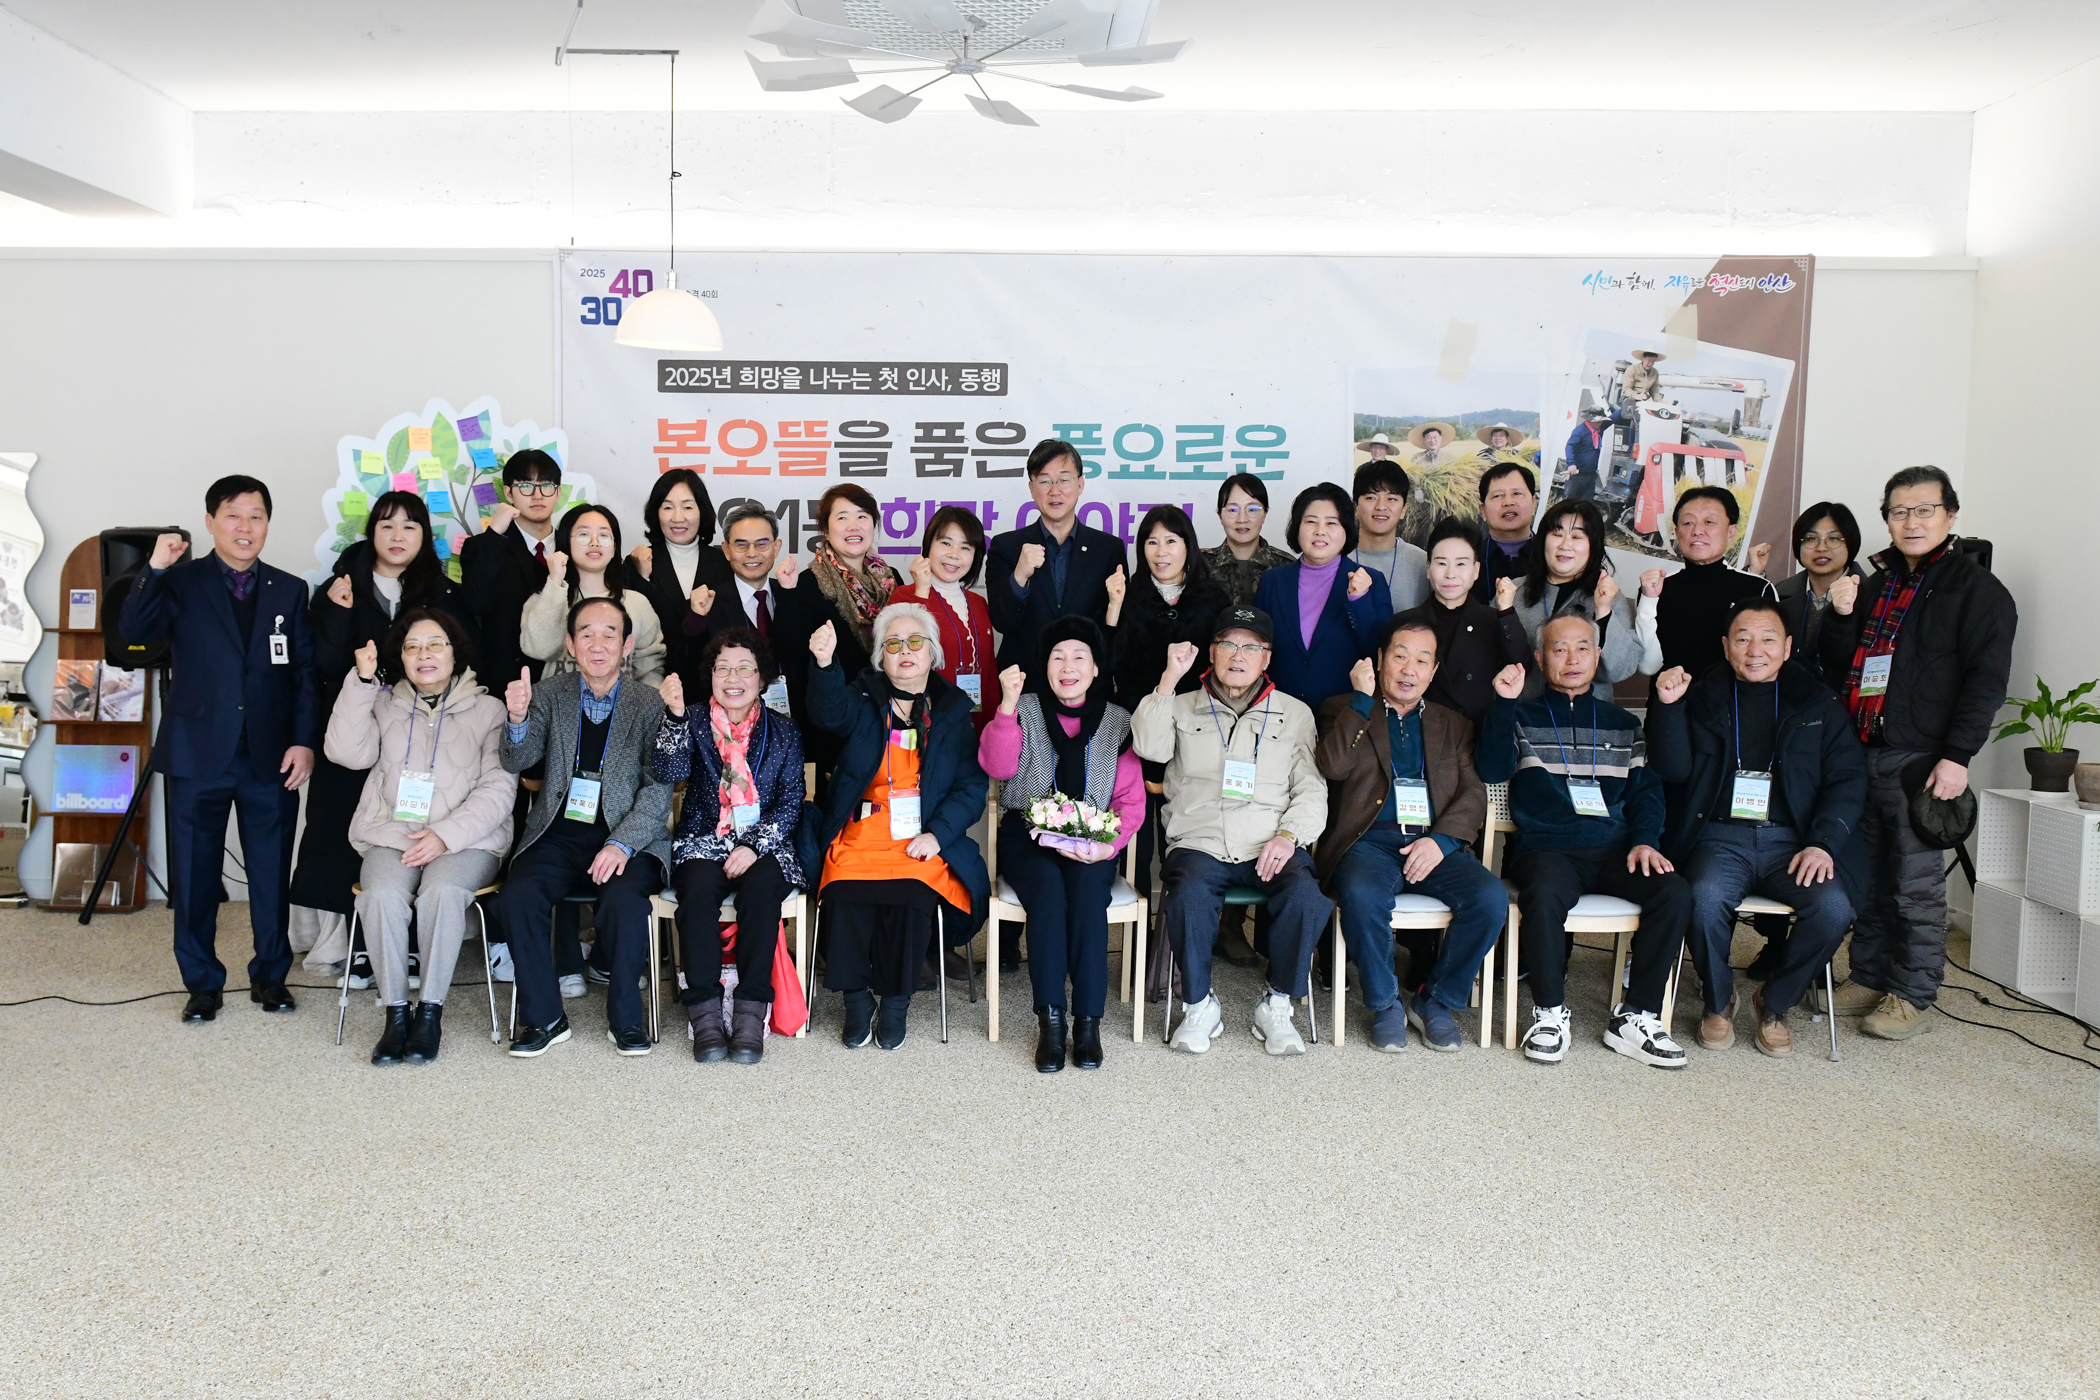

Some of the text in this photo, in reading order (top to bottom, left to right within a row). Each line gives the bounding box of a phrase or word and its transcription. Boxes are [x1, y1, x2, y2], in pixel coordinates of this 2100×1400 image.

[580, 268, 606, 278] 2025
[609, 269, 653, 298] 40
[1582, 270, 1624, 295] 시민과
[1664, 275, 1705, 296] 자유로운
[1708, 273, 1754, 296] 혁신도시
[1758, 273, 1796, 293] 안산
[701, 290, 718, 299] 40회
[580, 296, 622, 326] 30
[665, 365, 1001, 392] 2025년 희망을 나누는 첫 인사, 동행
[653, 418, 1290, 481] 본오뜰을 품은 풍요로운
[56, 793, 129, 810] billboard
